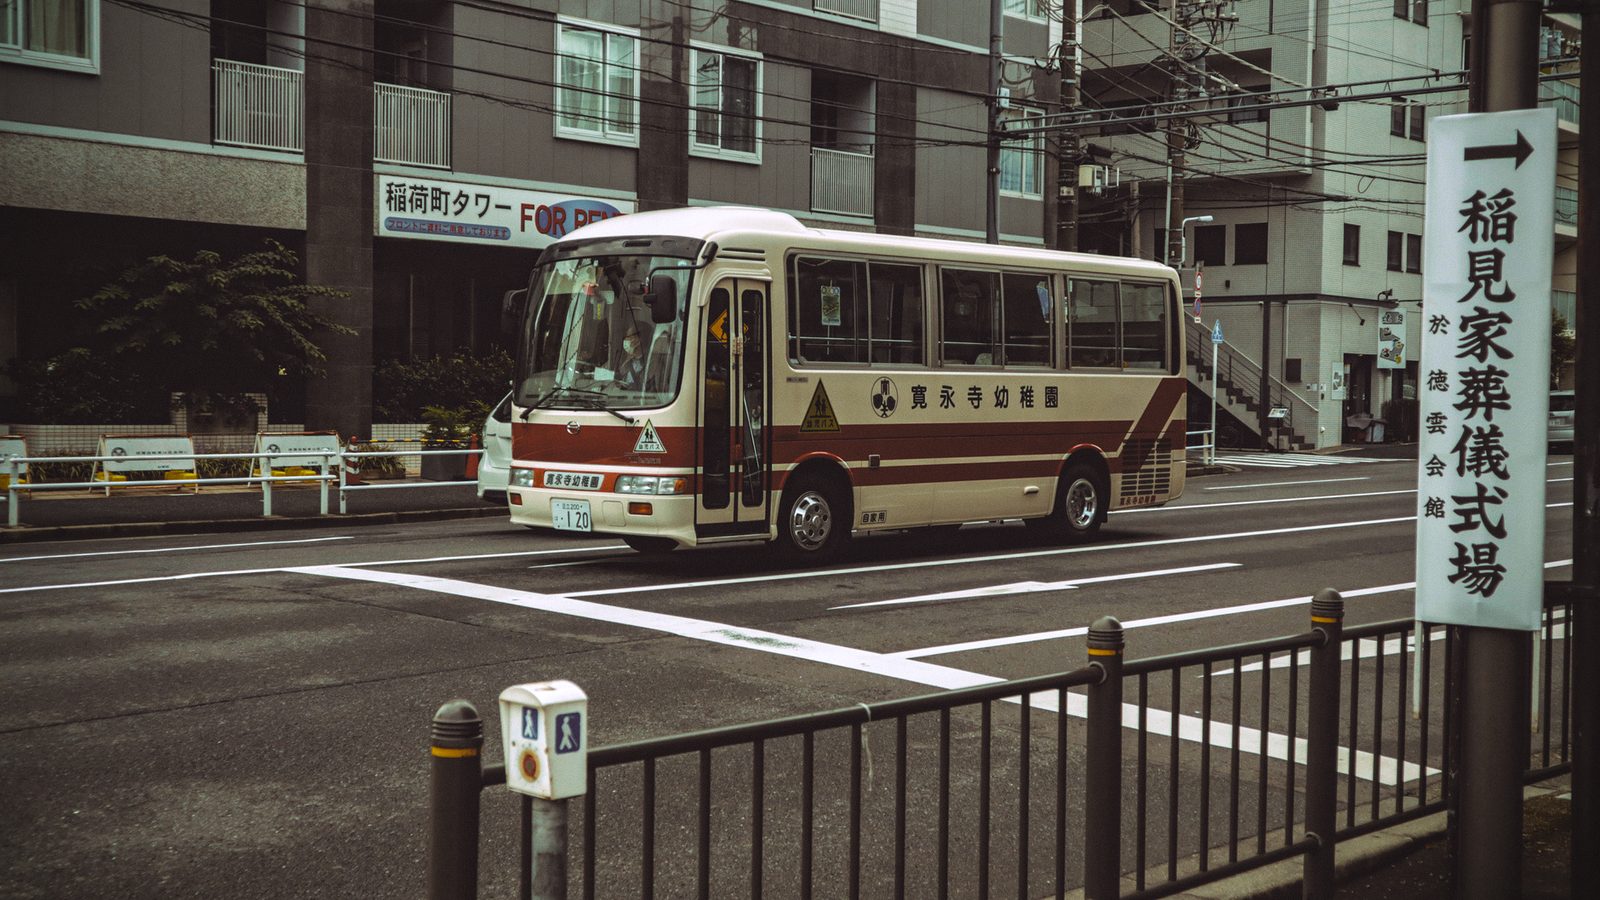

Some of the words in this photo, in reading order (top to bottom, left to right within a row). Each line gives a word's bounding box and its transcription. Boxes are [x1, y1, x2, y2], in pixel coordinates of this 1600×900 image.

[386, 181, 512, 218] 稲荷町タワー
[520, 203, 567, 236] FOR
[911, 385, 1059, 410] 寛永寺幼稚園
[1448, 187, 1518, 598] 稲見家葬儀式場
[1424, 369, 1450, 519] 徳雲会館
[545, 473, 600, 488] 寛永寺幼稚園
